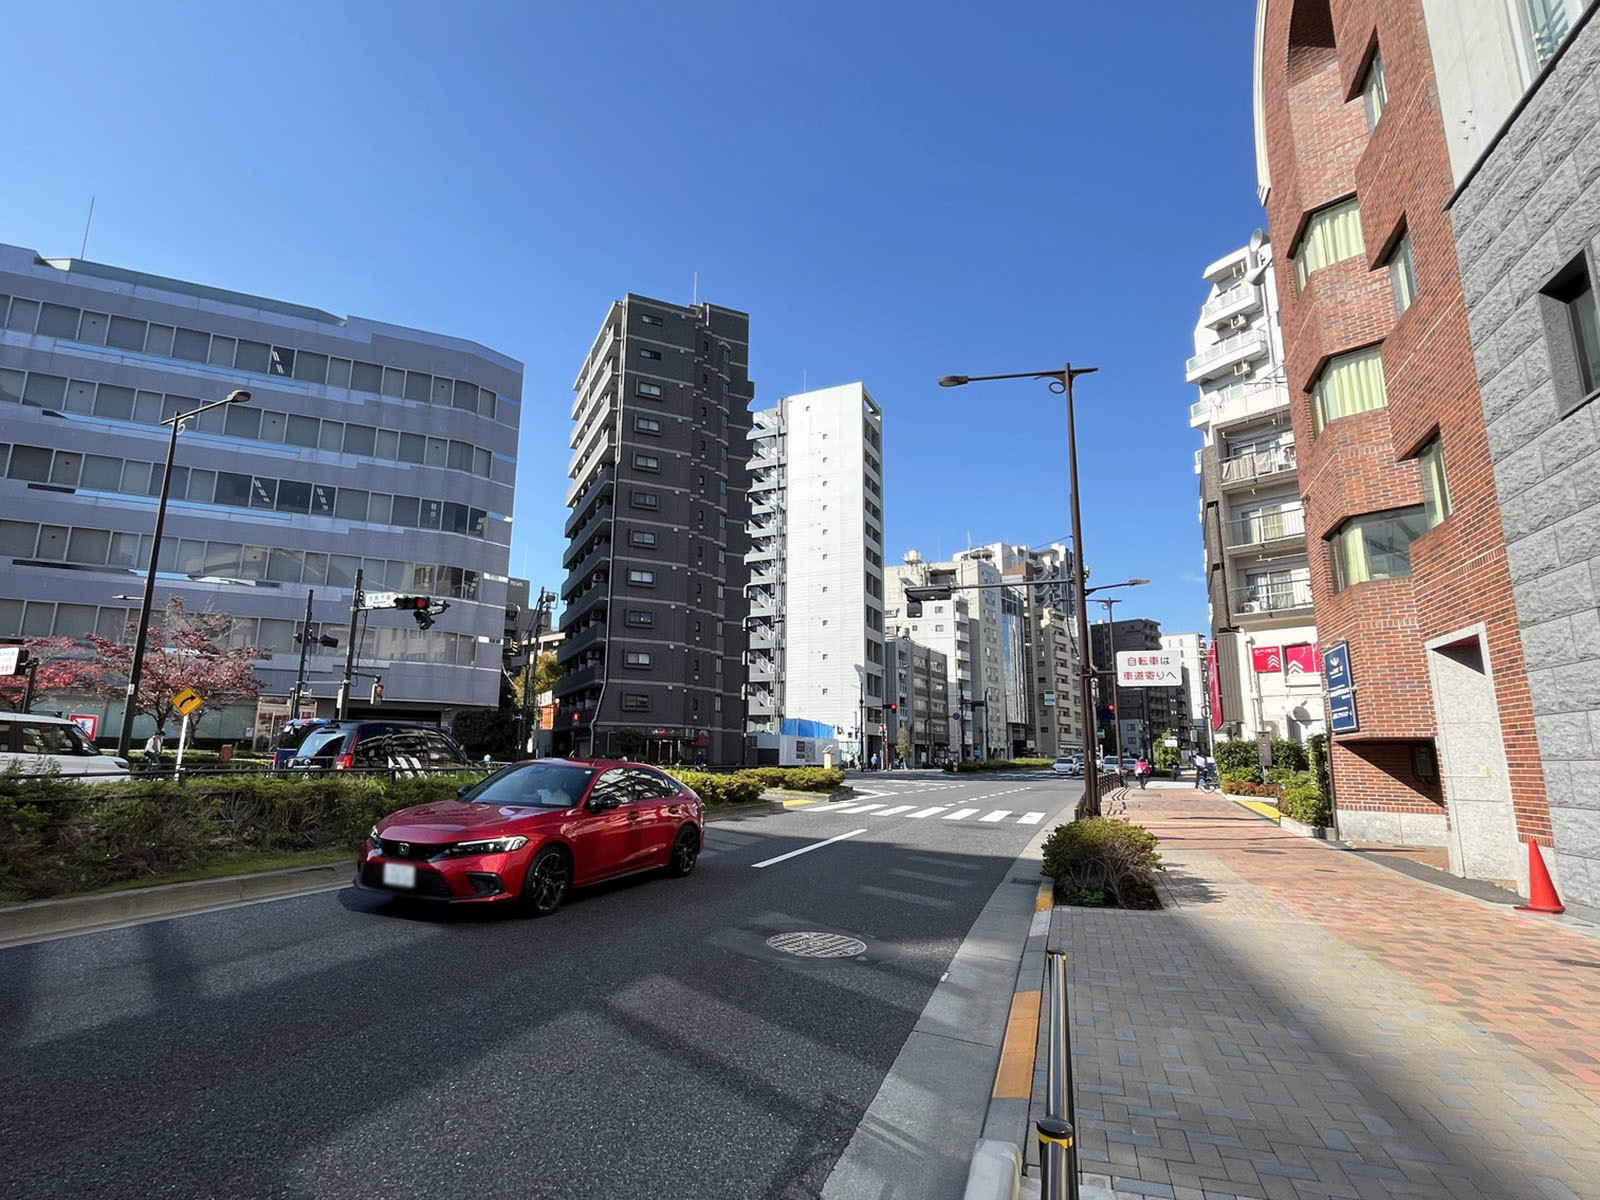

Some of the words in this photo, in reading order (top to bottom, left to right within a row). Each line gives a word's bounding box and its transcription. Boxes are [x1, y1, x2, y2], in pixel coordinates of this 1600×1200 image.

[1127, 656, 1170, 667] 自転車は
[1123, 671, 1177, 681] 車道寄りへ
